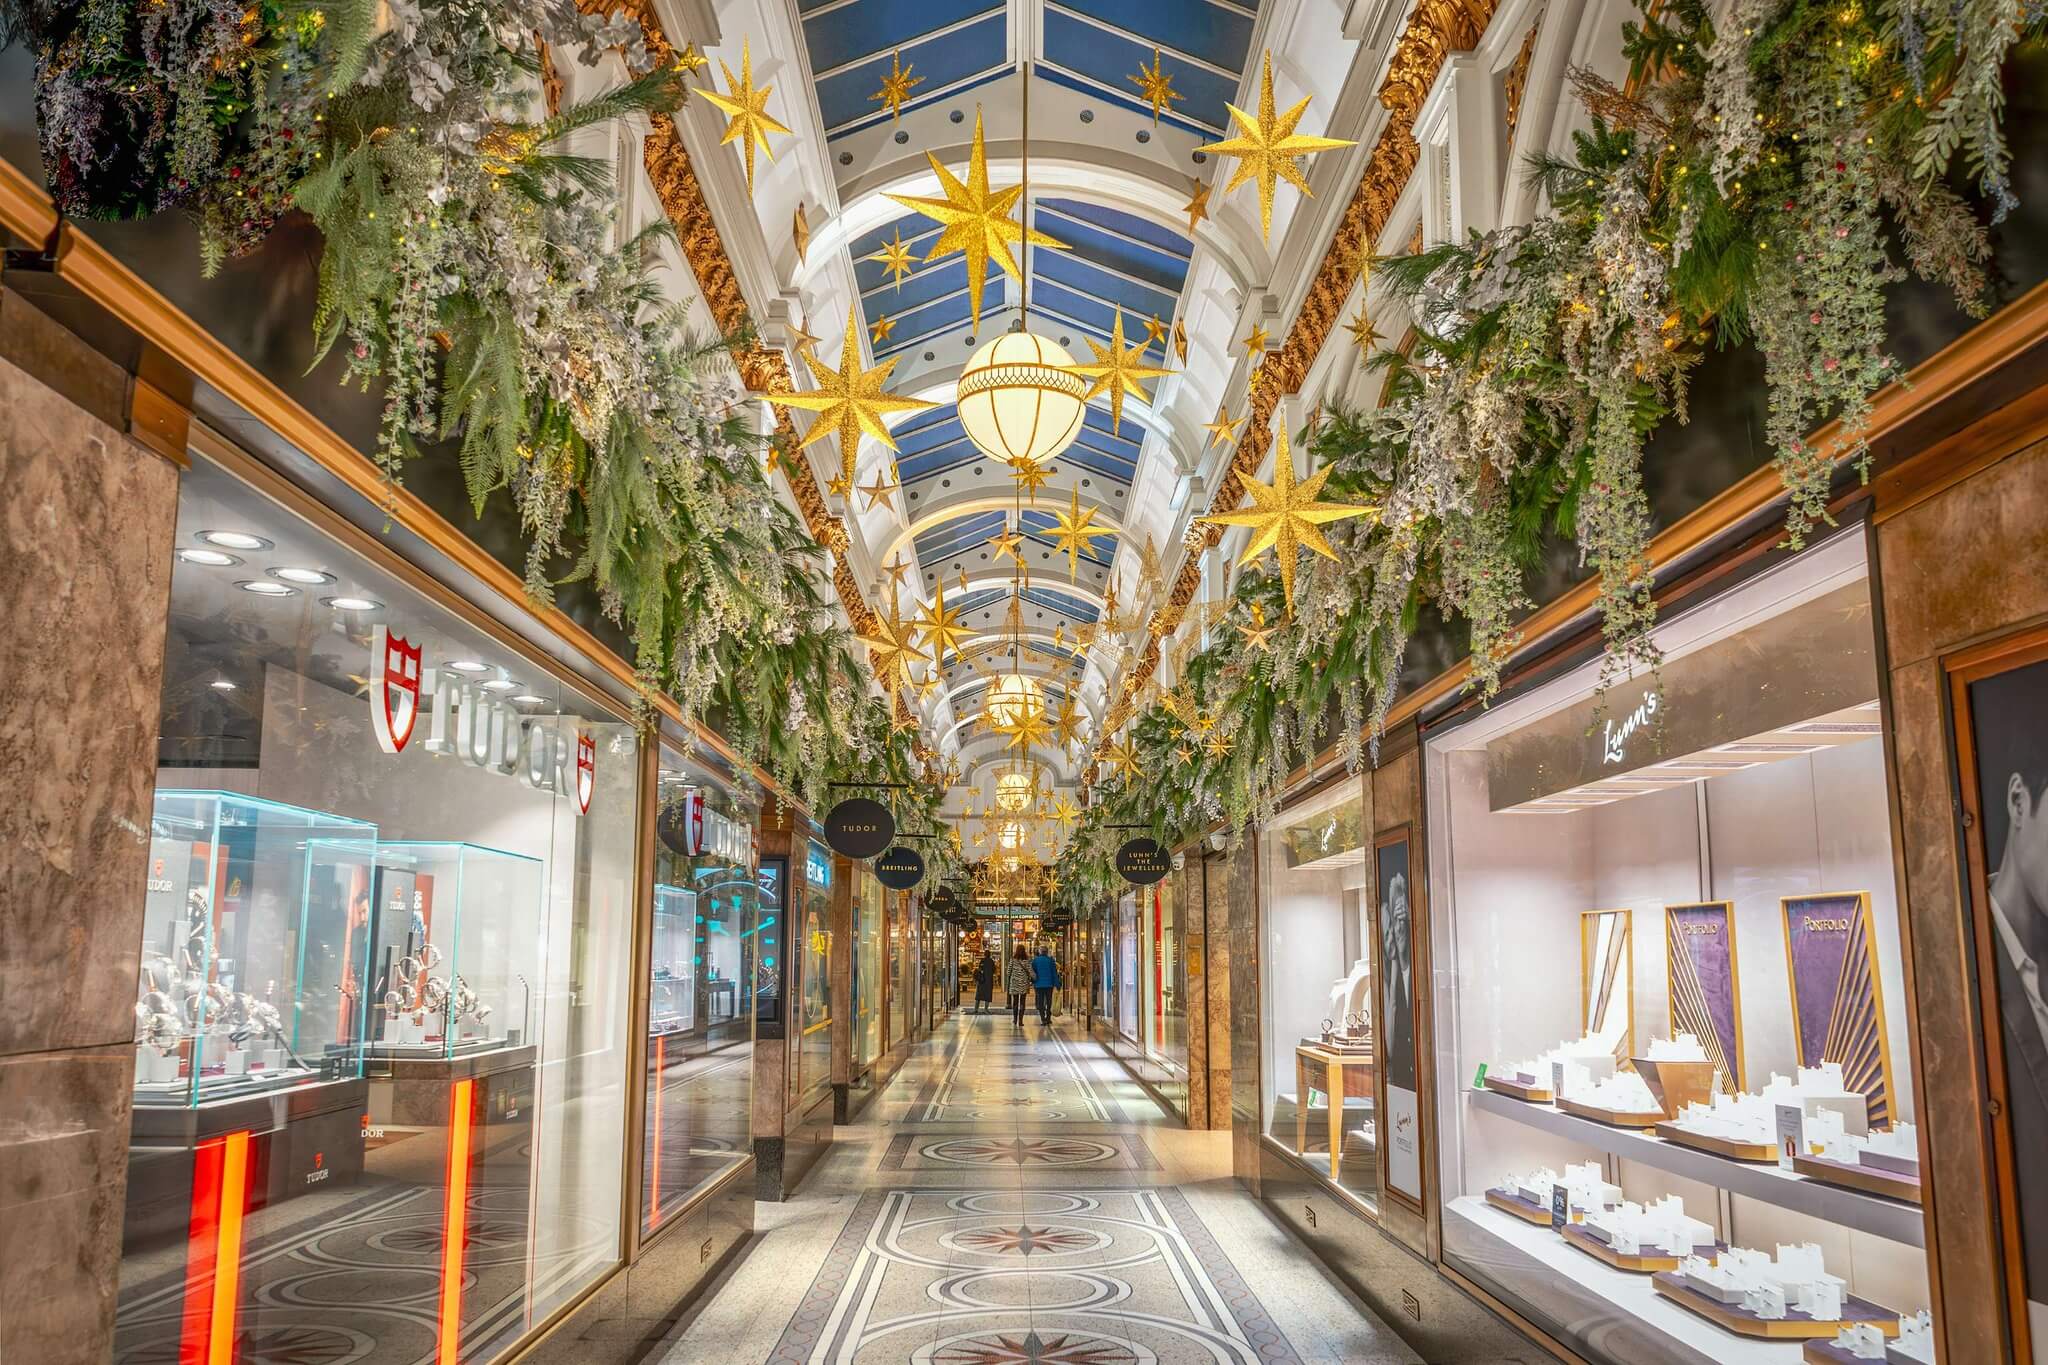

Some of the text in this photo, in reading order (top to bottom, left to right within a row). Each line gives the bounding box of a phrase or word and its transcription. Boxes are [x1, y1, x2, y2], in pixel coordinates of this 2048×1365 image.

[422, 668, 569, 798] TUDOR
[1603, 691, 1657, 764] Lunn's
[147, 880, 173, 892] UDOR
[1682, 922, 1718, 935] PORTFOLIO
[1805, 916, 1848, 932] PORTFOLIO
[361, 1129, 384, 1138] DOR
[306, 1168, 329, 1184] TUDOR
